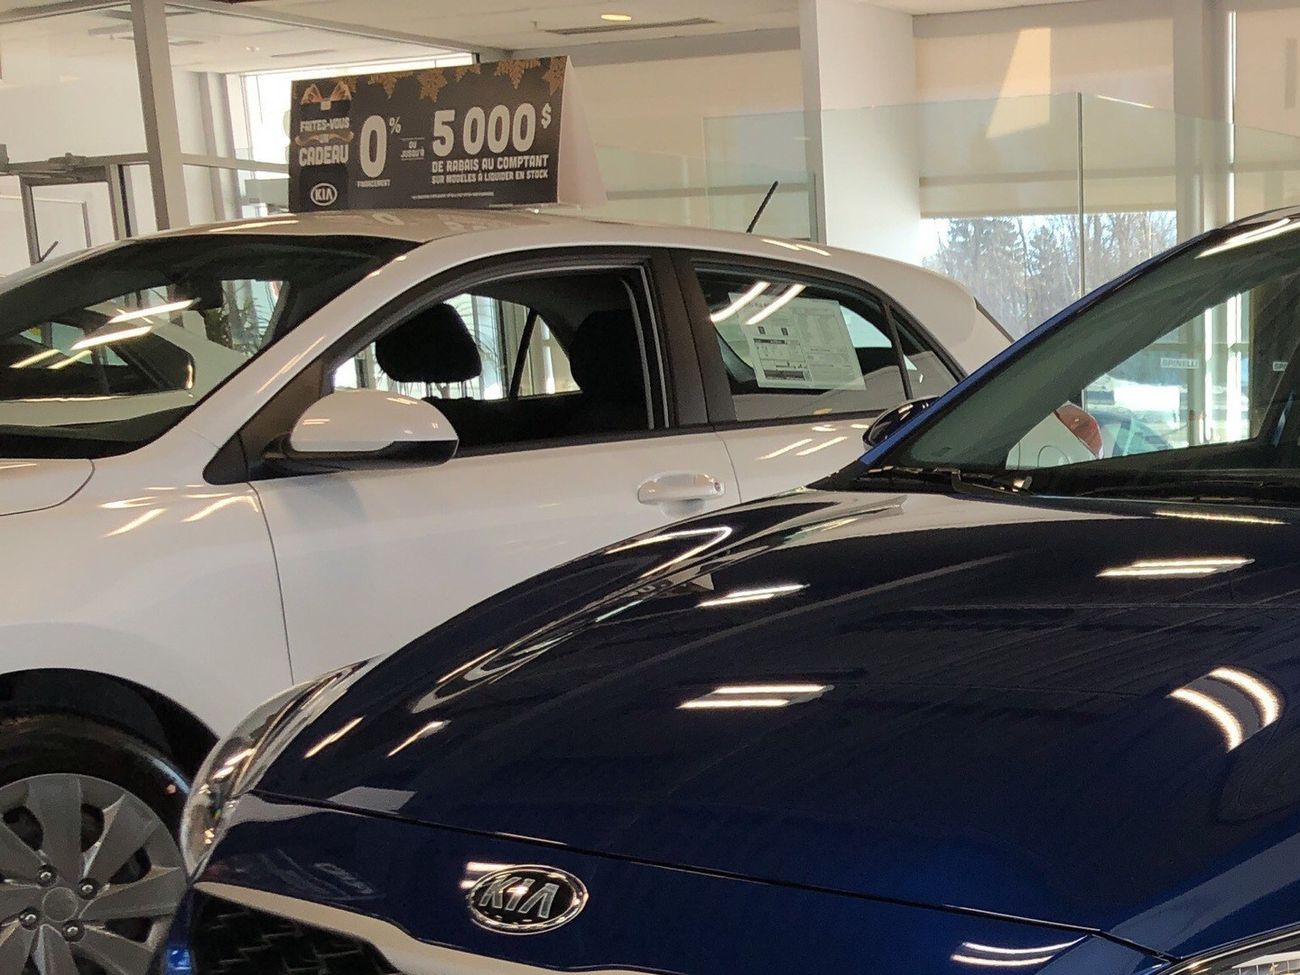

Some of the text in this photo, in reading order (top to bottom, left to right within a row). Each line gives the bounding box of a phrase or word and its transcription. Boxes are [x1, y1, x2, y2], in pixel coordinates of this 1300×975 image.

[299, 144, 349, 167] CADEAU
[432, 154, 549, 173] DE RABAIS AU COMPTANT
[526, 169, 549, 179] STOCK
[479, 874, 560, 919] KIA
